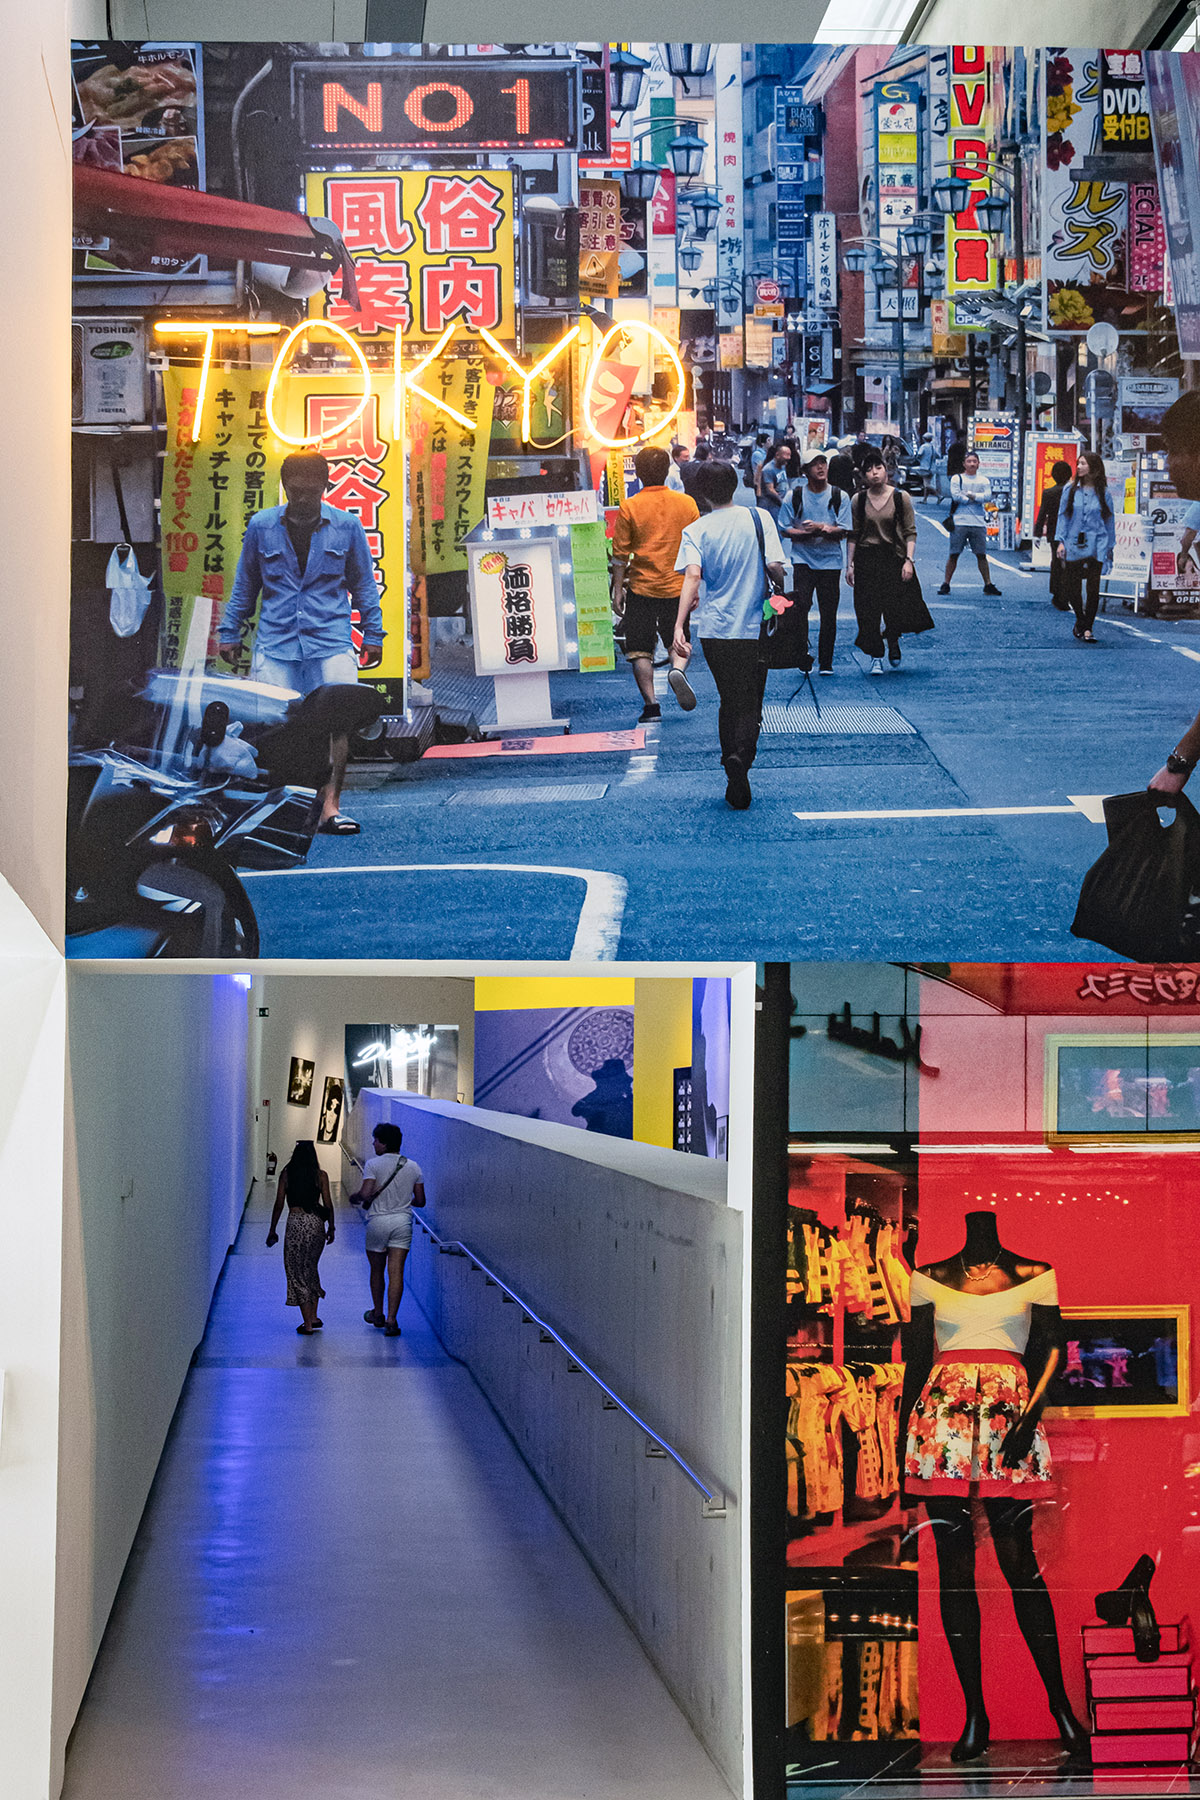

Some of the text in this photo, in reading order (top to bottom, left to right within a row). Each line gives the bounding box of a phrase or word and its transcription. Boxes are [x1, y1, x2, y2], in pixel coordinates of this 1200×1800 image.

[324, 175, 504, 255] 風俗
[89, 326, 136, 334] TOSHIBA
[154, 315, 687, 451] TOKYO
[975, 440, 1012, 450] ENTRANCE
[492, 501, 535, 521] キャバ
[502, 565, 536, 662] 価格勝負
